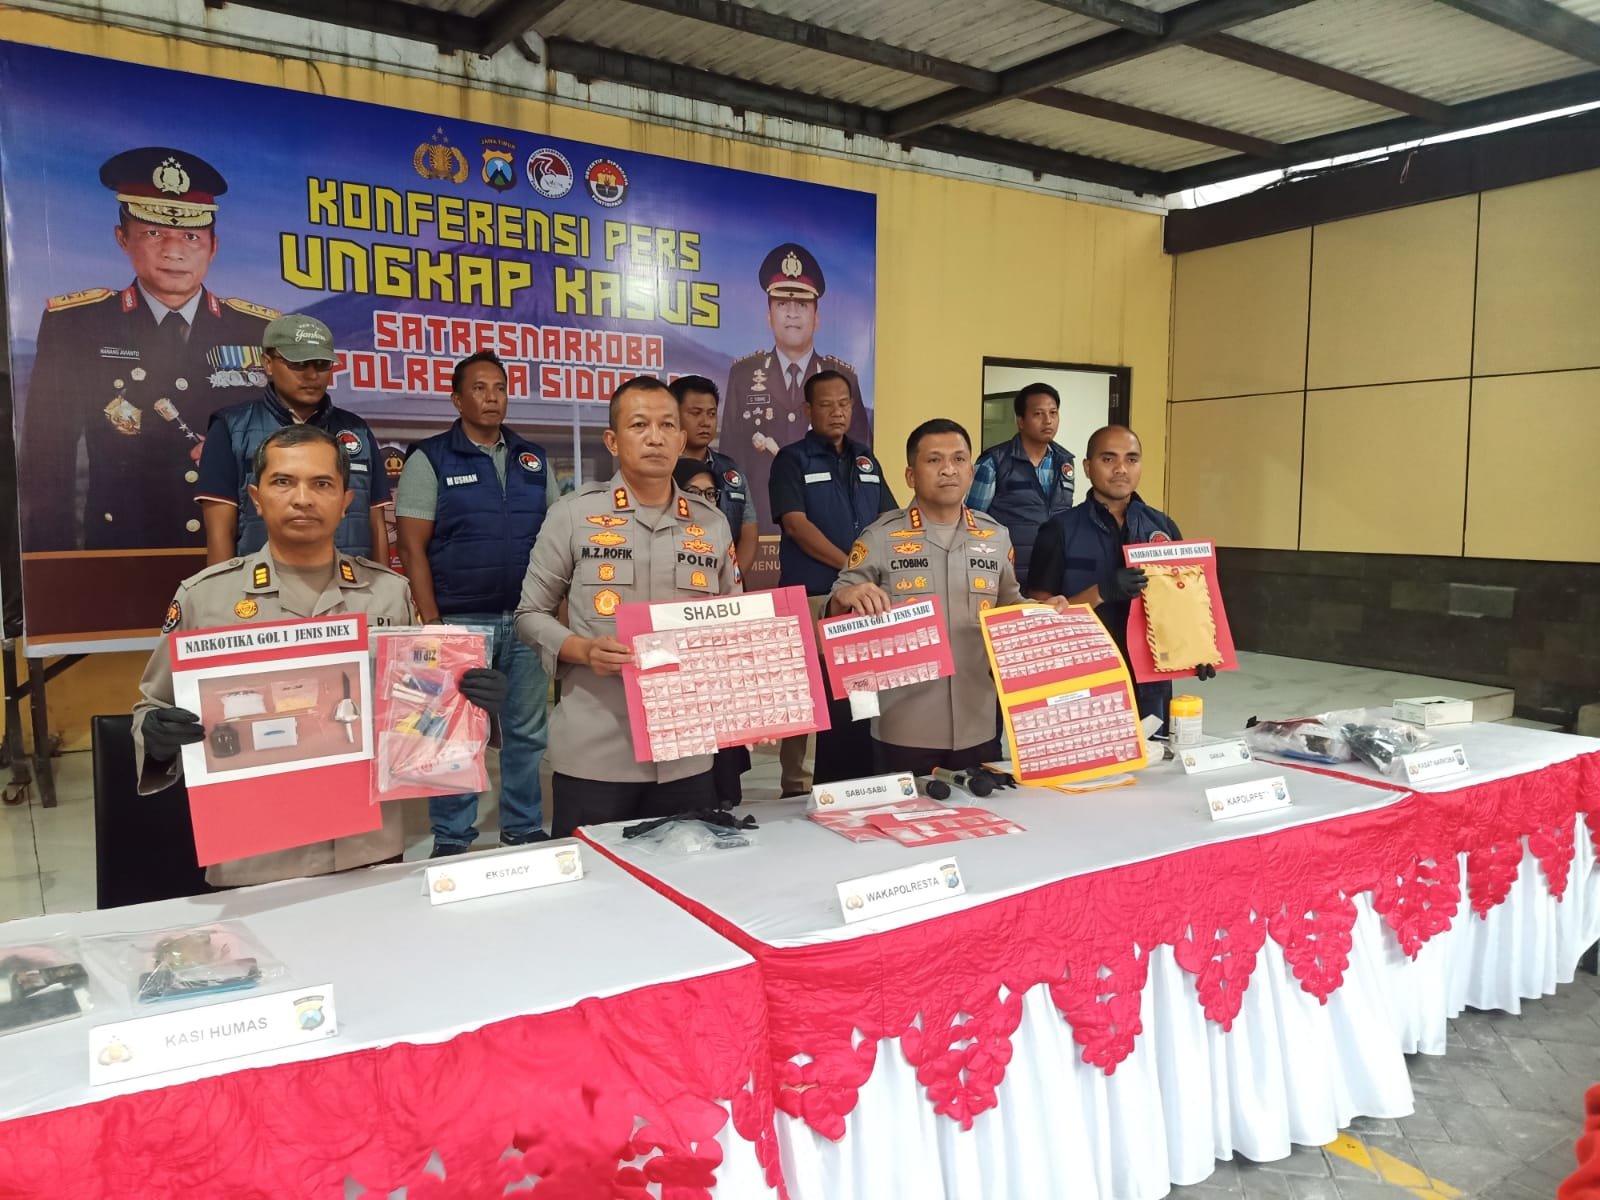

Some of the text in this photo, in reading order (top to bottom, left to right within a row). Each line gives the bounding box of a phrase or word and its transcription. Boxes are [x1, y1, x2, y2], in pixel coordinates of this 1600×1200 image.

[308, 176, 700, 272] KONFERENSI PERS
[280, 232, 720, 328] UNGKAP KASUS
[375, 312, 663, 369] SATRESNARKOBA
[326, 350, 680, 402] POLREA SIDO
[581, 547, 633, 560] M.Z.ROFIK
[677, 552, 718, 569] POLRI
[891, 558, 929, 570] C.TOBING
[970, 558, 998, 570] POLRI
[683, 602, 741, 621] SHABU
[827, 618, 869, 636] NARKOTIKA
[893, 610, 912, 622] JENIS
[913, 604, 930, 616] SABU
[185, 625, 350, 654] NARKOTIKA GOL I JENIS INEX
[845, 785, 887, 798] SABU-SABU
[1226, 790, 1270, 806] KAPOLRES
[485, 865, 530, 880] EKSTACY
[866, 877, 940, 902] WAKAPOLRESTA
[165, 1017, 268, 1048] KASI HUMAS
